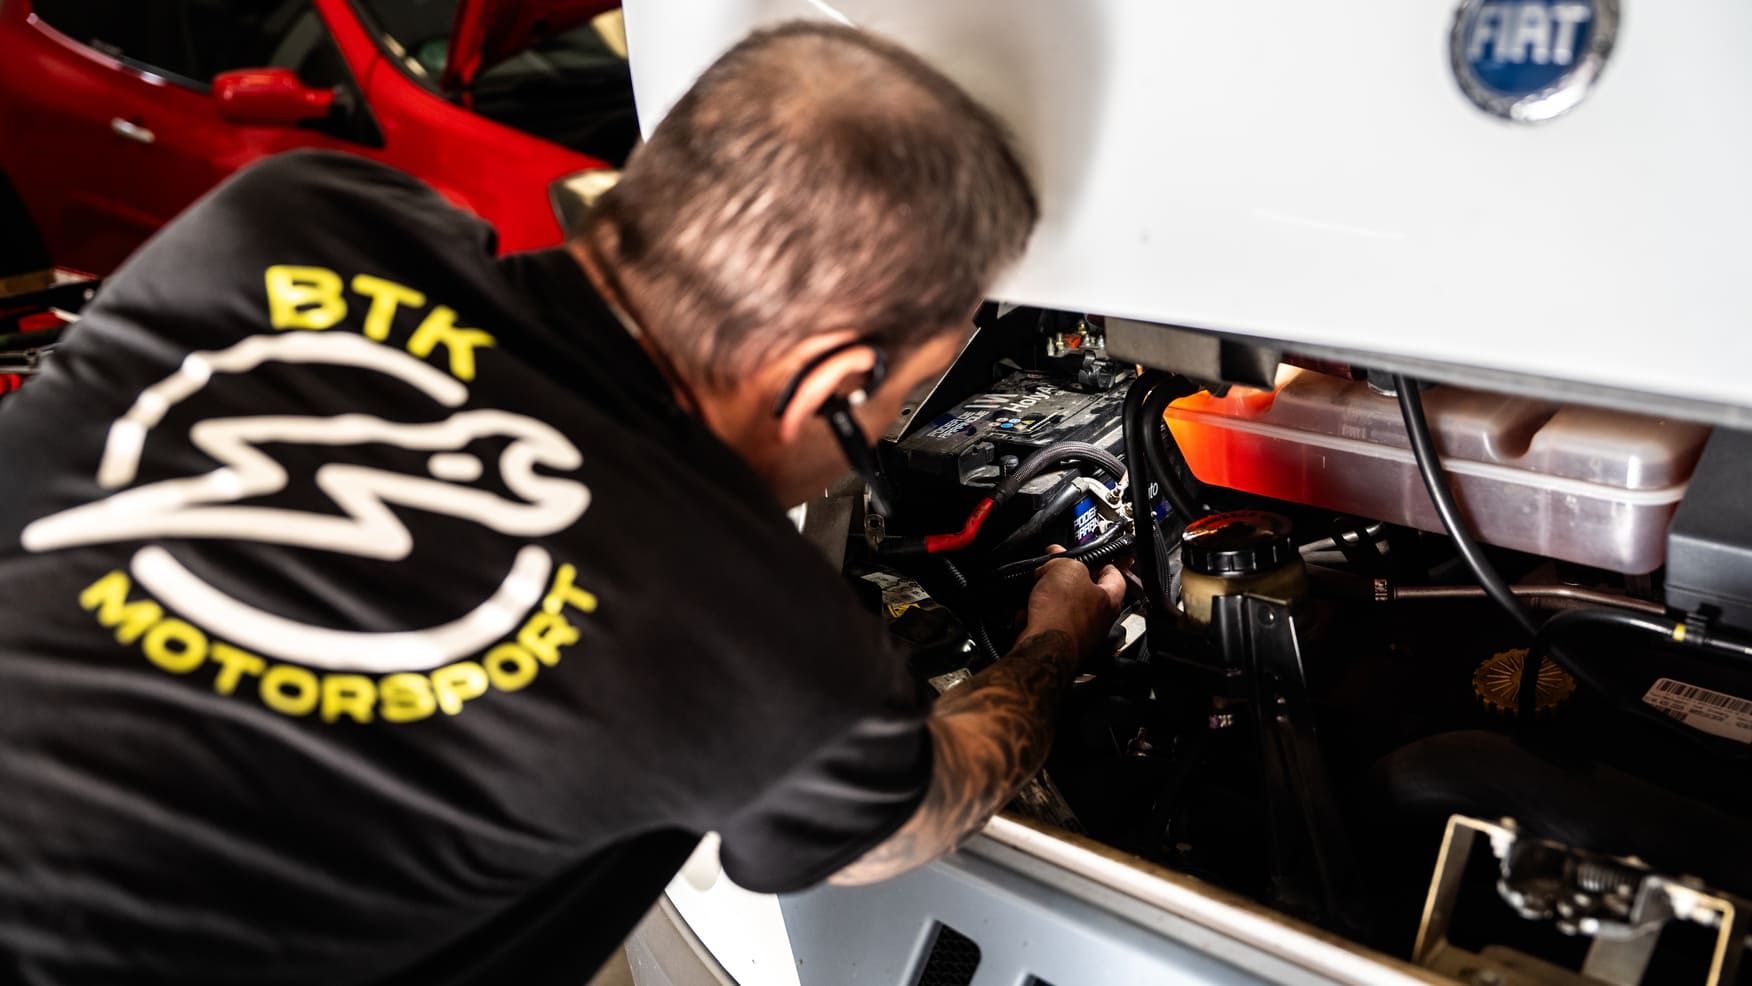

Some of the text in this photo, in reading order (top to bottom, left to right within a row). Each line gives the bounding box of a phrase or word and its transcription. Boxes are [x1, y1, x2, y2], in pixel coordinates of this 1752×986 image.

[1467, 2, 1592, 65] FIAT
[265, 264, 495, 381] BTK
[79, 563, 598, 724] MOTORSPORT
